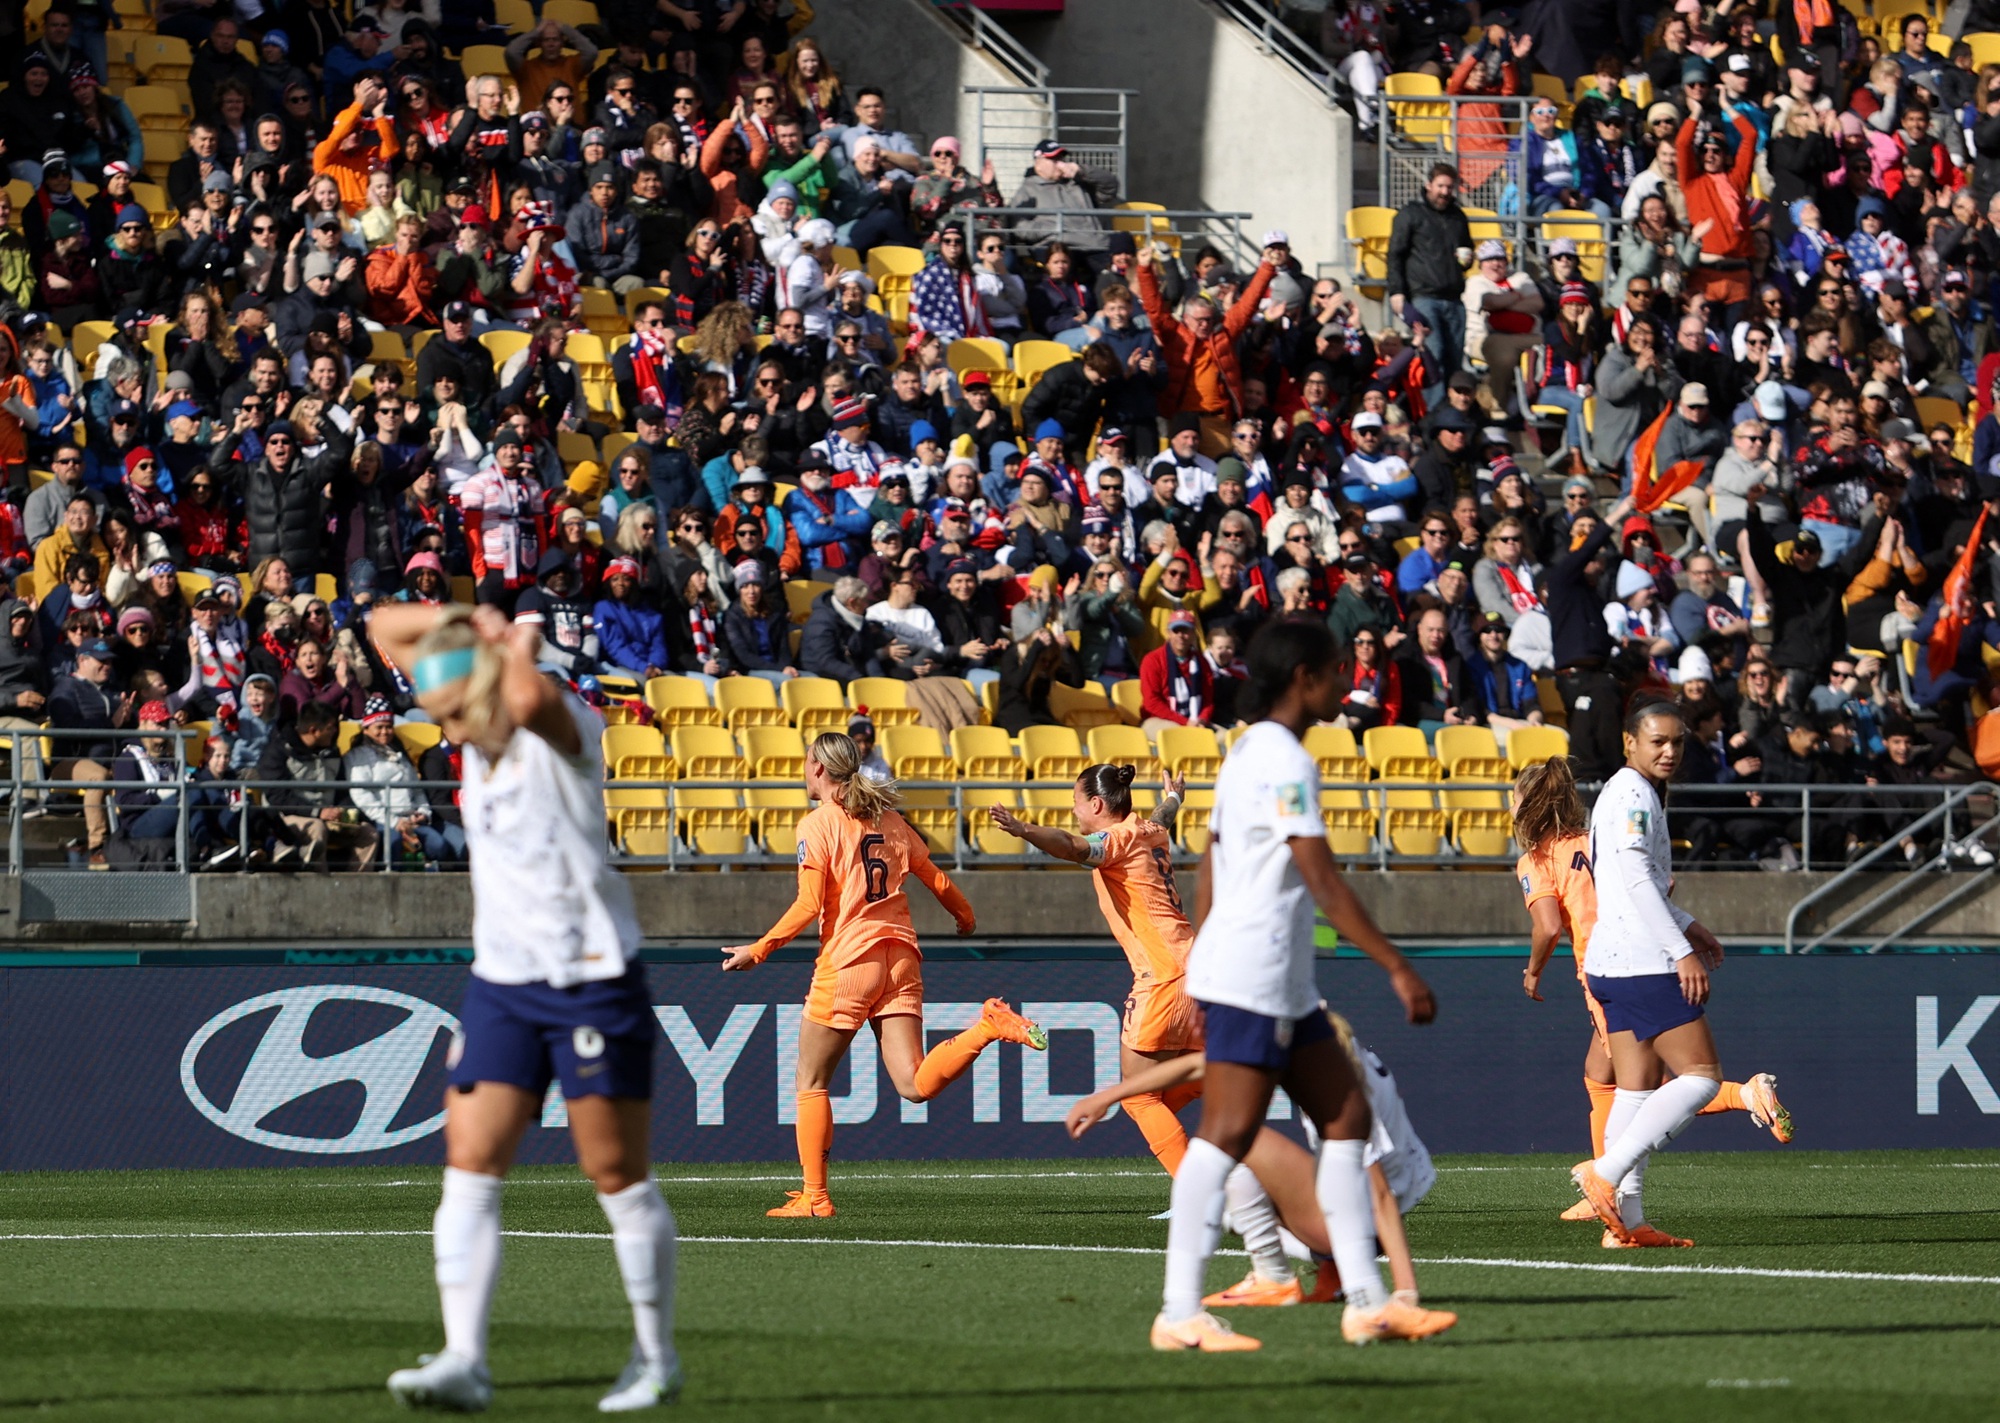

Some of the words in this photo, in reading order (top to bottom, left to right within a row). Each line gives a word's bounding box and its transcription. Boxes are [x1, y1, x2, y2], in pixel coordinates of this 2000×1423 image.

[860, 833, 889, 903] 6
[1151, 847, 1183, 914] 8
[541, 1001, 1292, 1127] YUND
[1916, 995, 2000, 1115] K
